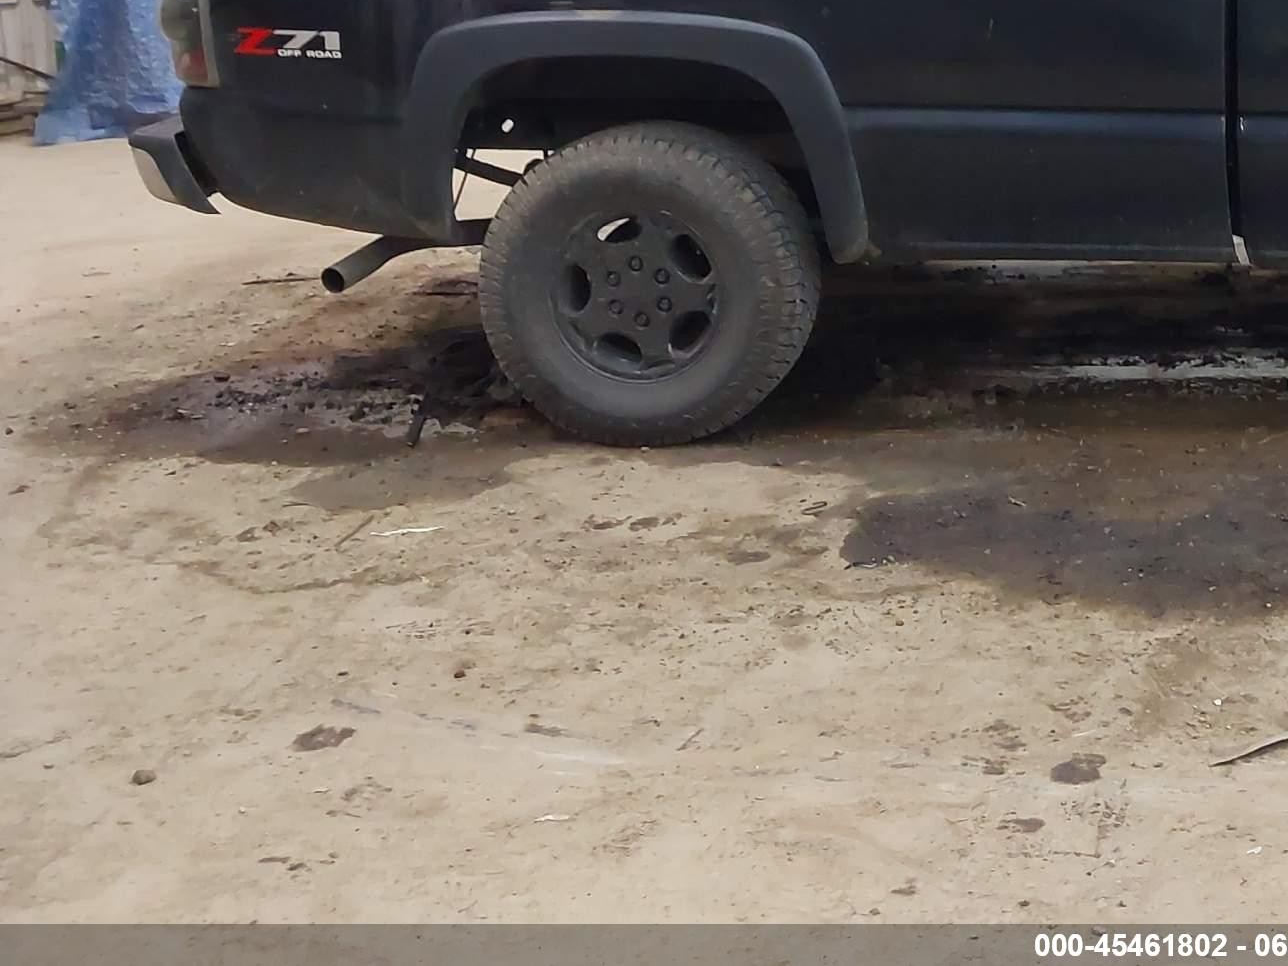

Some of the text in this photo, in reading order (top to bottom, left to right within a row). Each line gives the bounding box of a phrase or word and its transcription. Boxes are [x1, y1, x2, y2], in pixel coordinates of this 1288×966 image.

[233, 26, 341, 56] Z71
[277, 48, 343, 60] OFF ROAD
